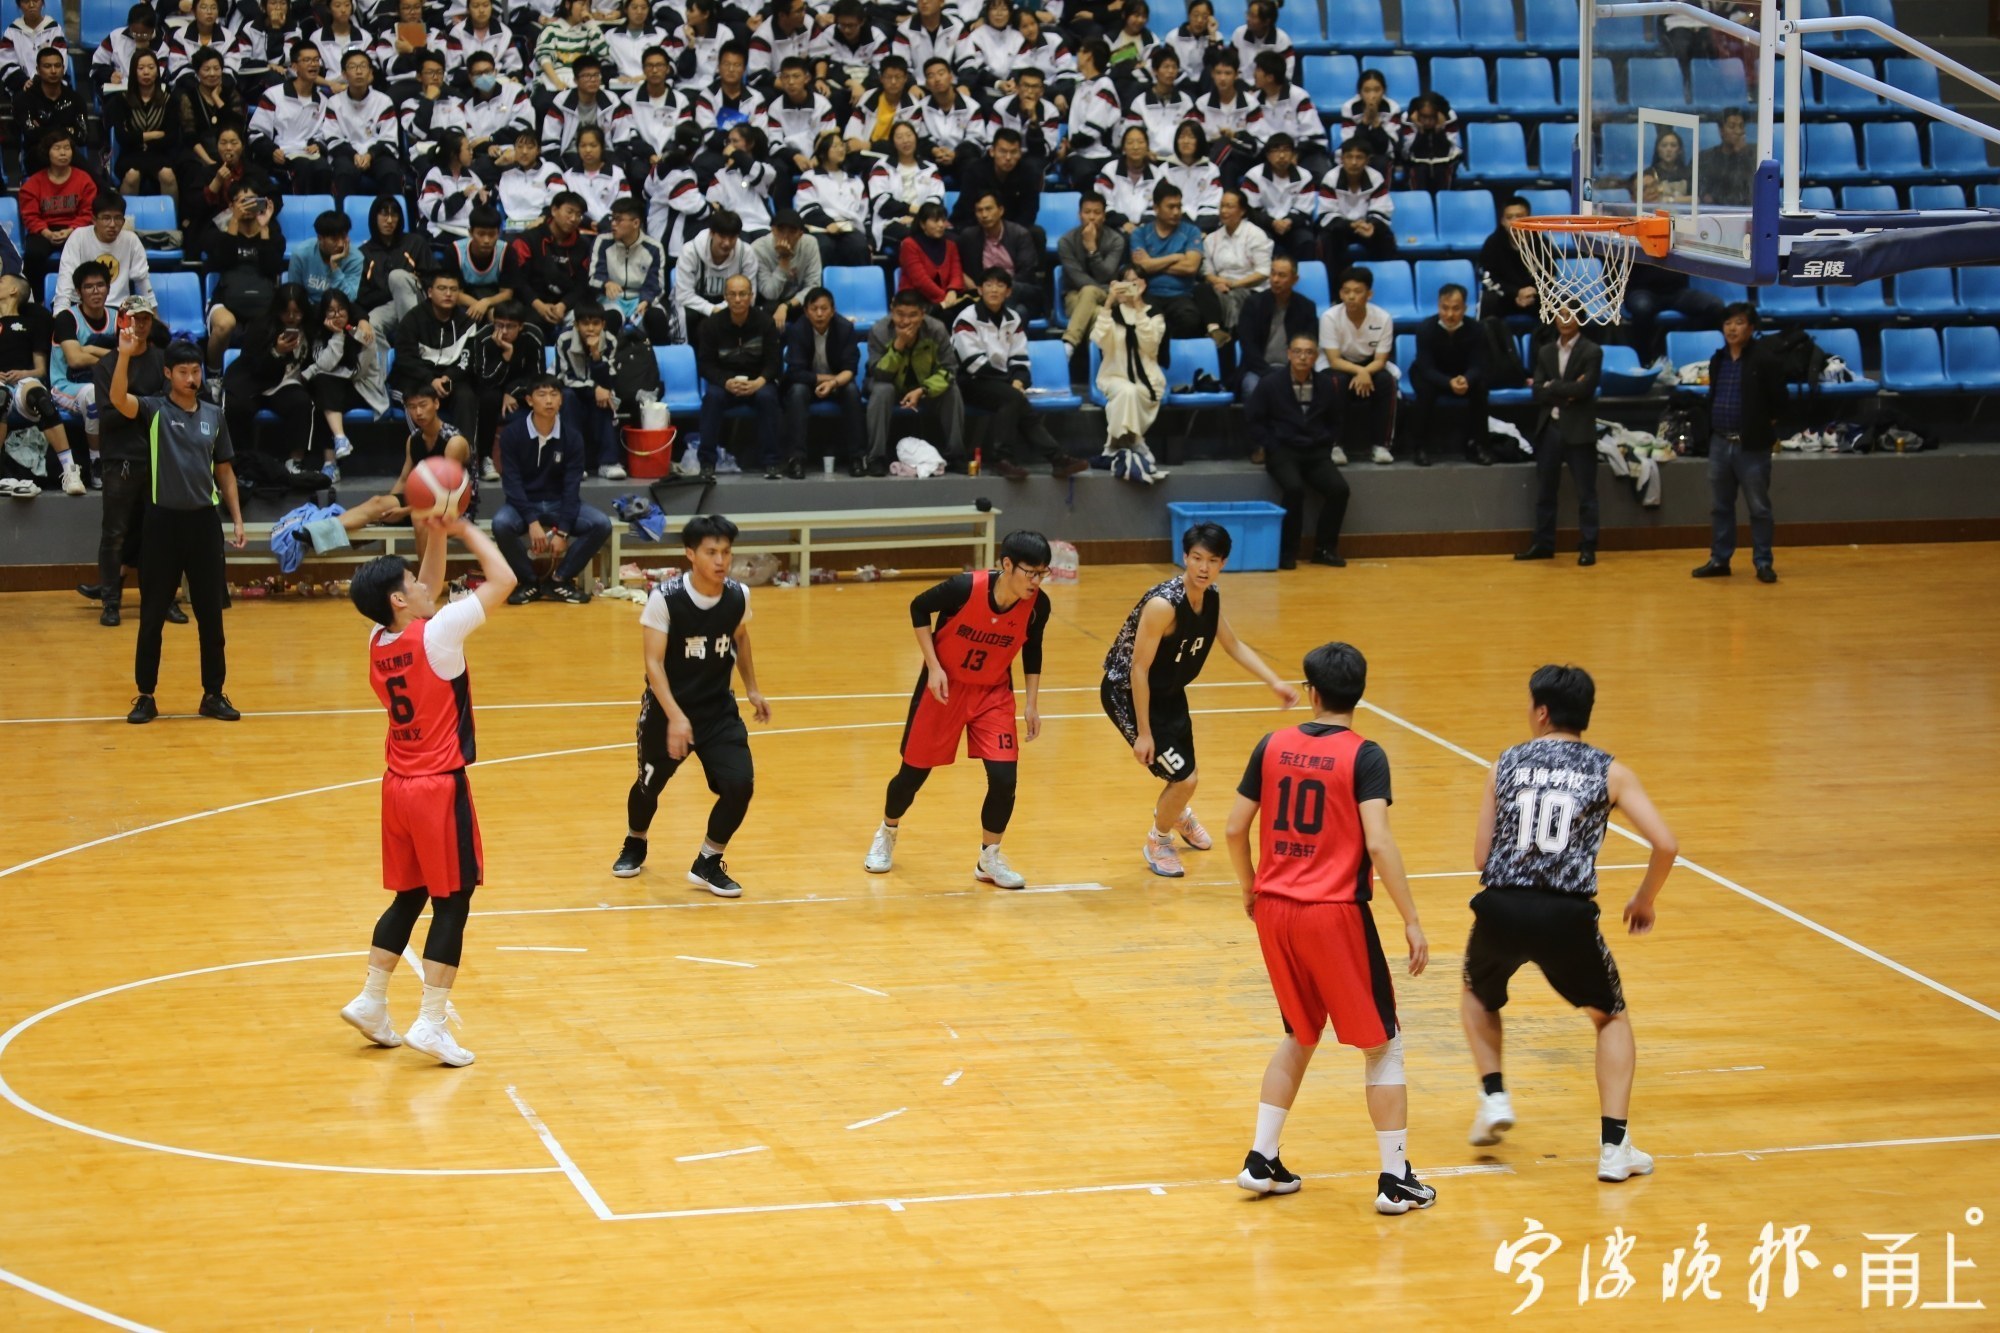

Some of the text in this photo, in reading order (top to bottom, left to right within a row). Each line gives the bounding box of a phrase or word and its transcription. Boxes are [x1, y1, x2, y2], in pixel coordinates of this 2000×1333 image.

[1803, 260, 1845, 278] 金陵
[684, 633, 731, 660] 高中
[955, 623, 1015, 648] 象山中学
[960, 648, 988, 672] 13
[385, 675, 415, 725] 6
[997, 732, 1014, 750] 13
[1156, 746, 1186, 776] 15
[1279, 751, 1336, 771] 东红集团
[1514, 767, 1585, 789] 滨海学校
[1272, 776, 1326, 836] 10
[1515, 787, 1576, 855] 10
